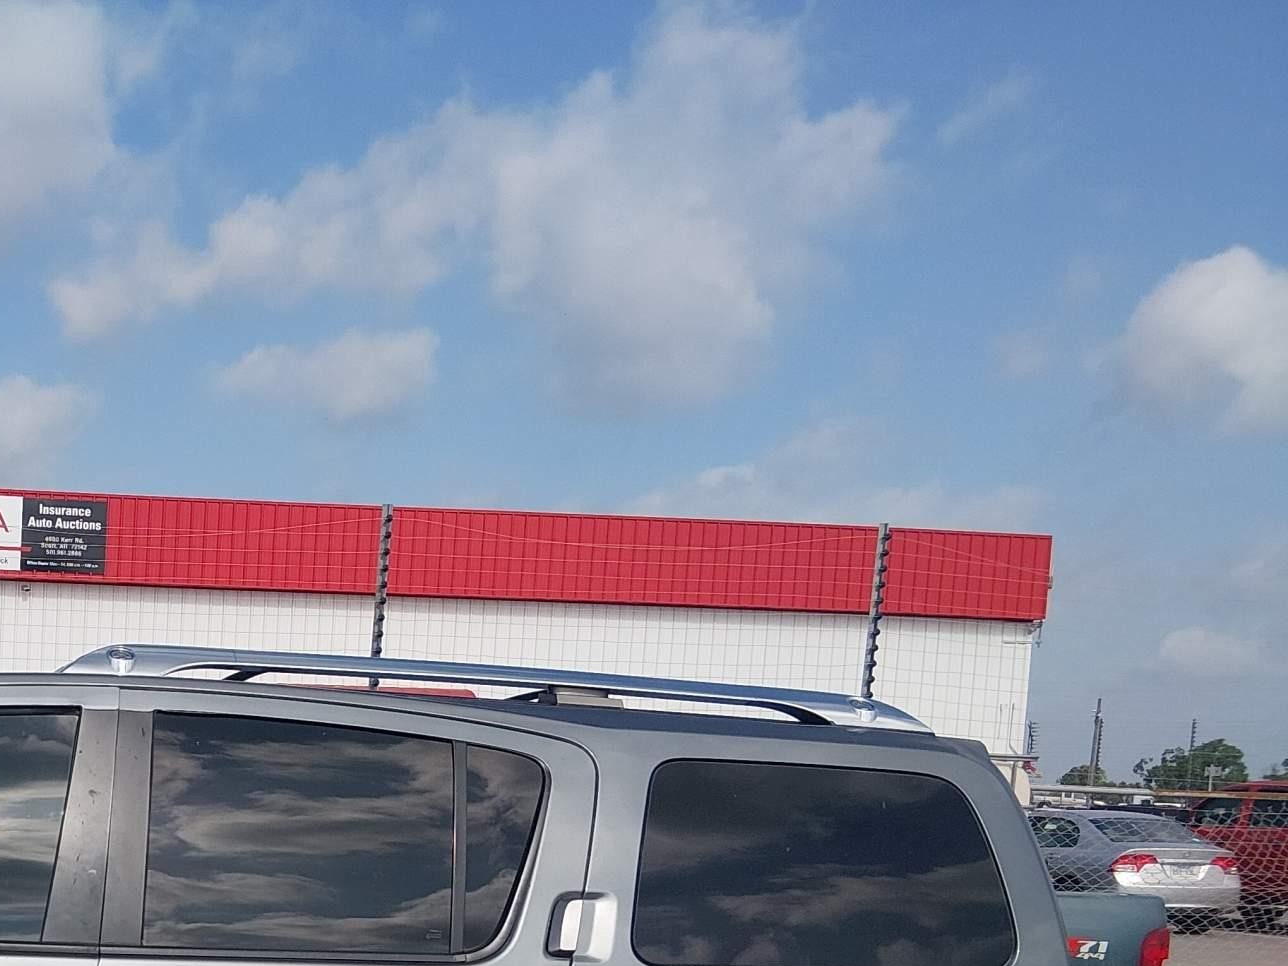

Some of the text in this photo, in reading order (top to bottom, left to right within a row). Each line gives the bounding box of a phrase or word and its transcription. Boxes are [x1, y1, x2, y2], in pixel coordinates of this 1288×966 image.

[39, 504, 92, 517] Insurance
[28, 516, 102, 531] Auto Auctions
